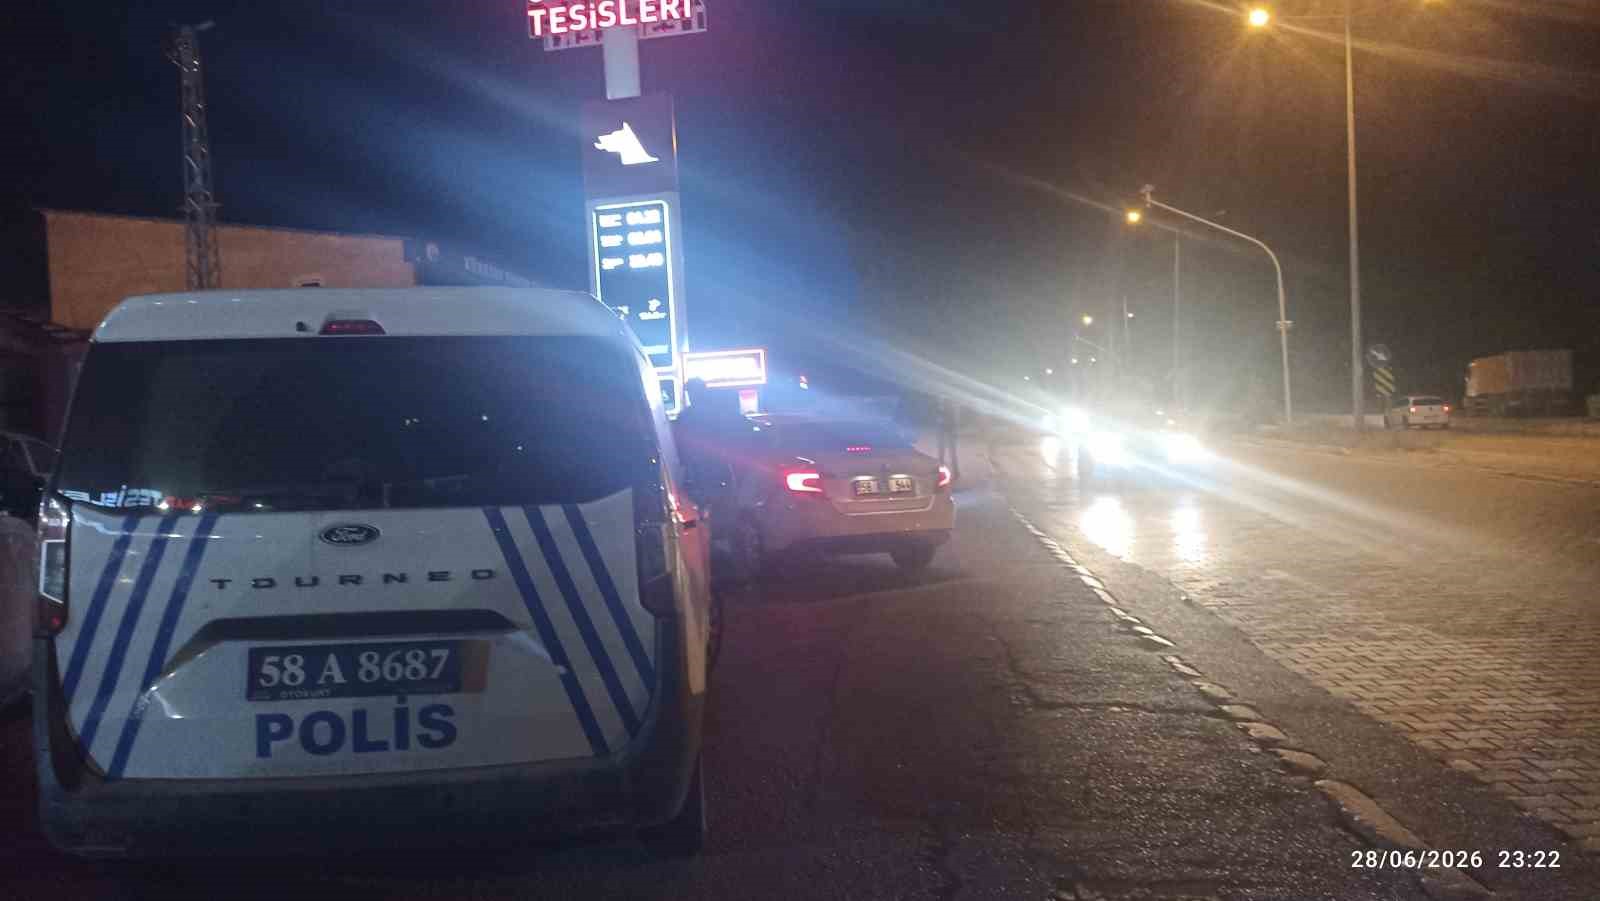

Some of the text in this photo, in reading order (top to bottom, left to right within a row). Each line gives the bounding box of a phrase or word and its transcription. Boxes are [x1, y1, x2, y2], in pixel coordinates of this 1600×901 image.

[209, 569, 496, 589] TOURNEO
[259, 649, 449, 687] 58 A 8687
[255, 695, 458, 759] POLİS
